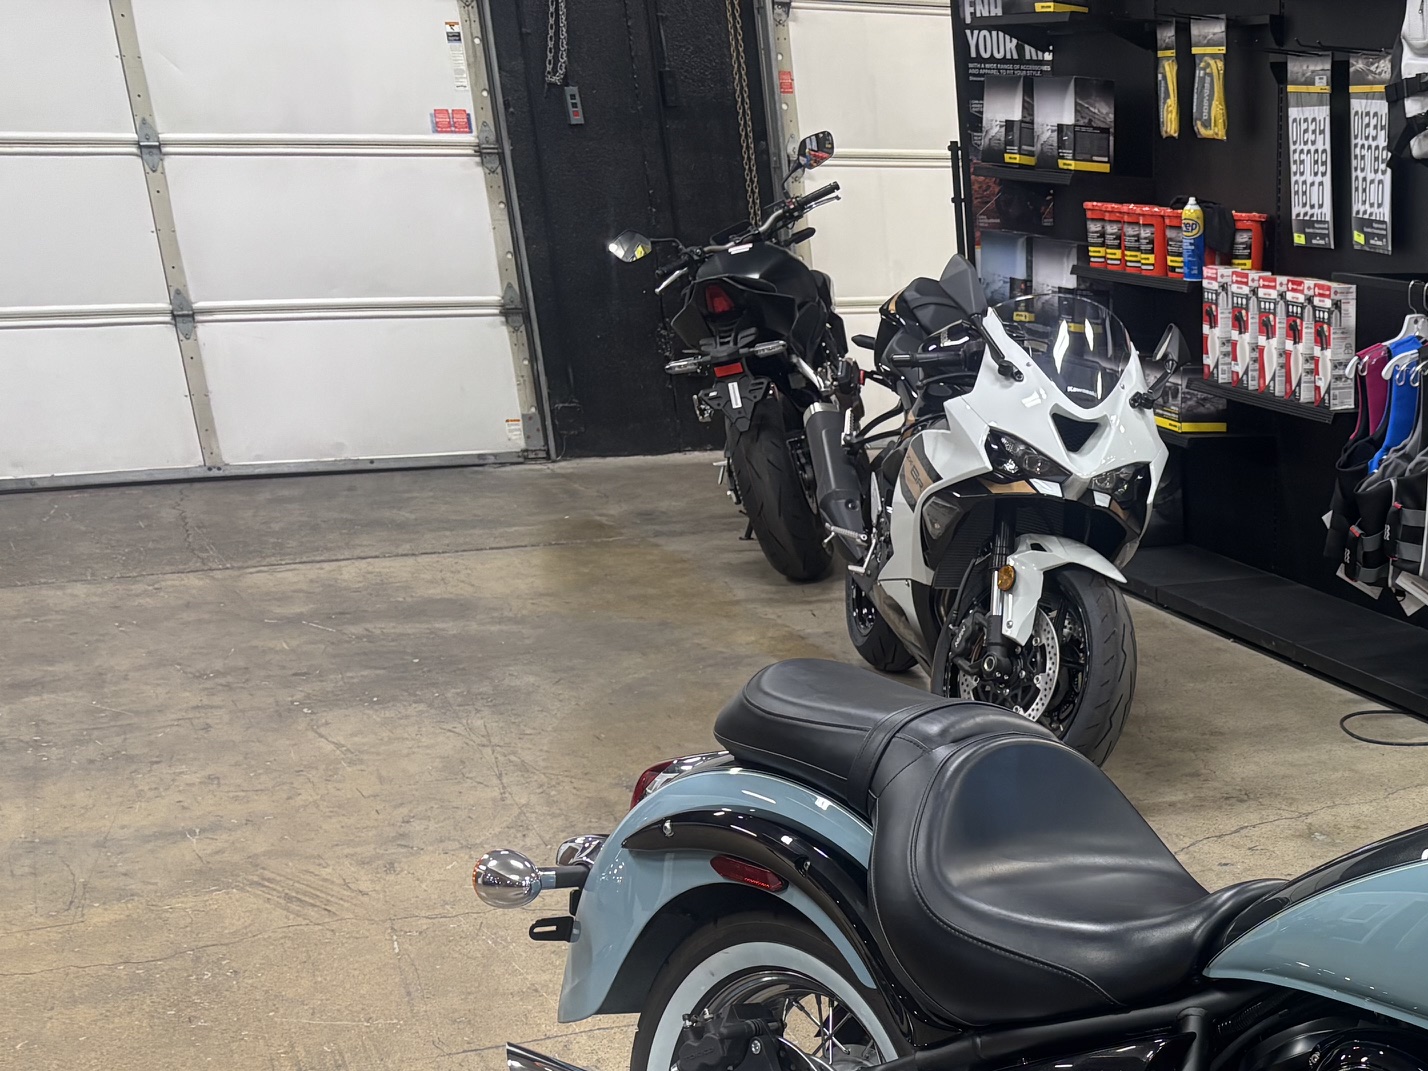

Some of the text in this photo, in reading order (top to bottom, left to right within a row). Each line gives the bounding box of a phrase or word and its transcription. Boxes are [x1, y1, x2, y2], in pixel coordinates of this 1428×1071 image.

[965, 29, 1019, 60] YOUR
[1291, 116, 1326, 146] 01234
[1292, 148, 1328, 178] 56789
[1293, 179, 1325, 210] ABCD
